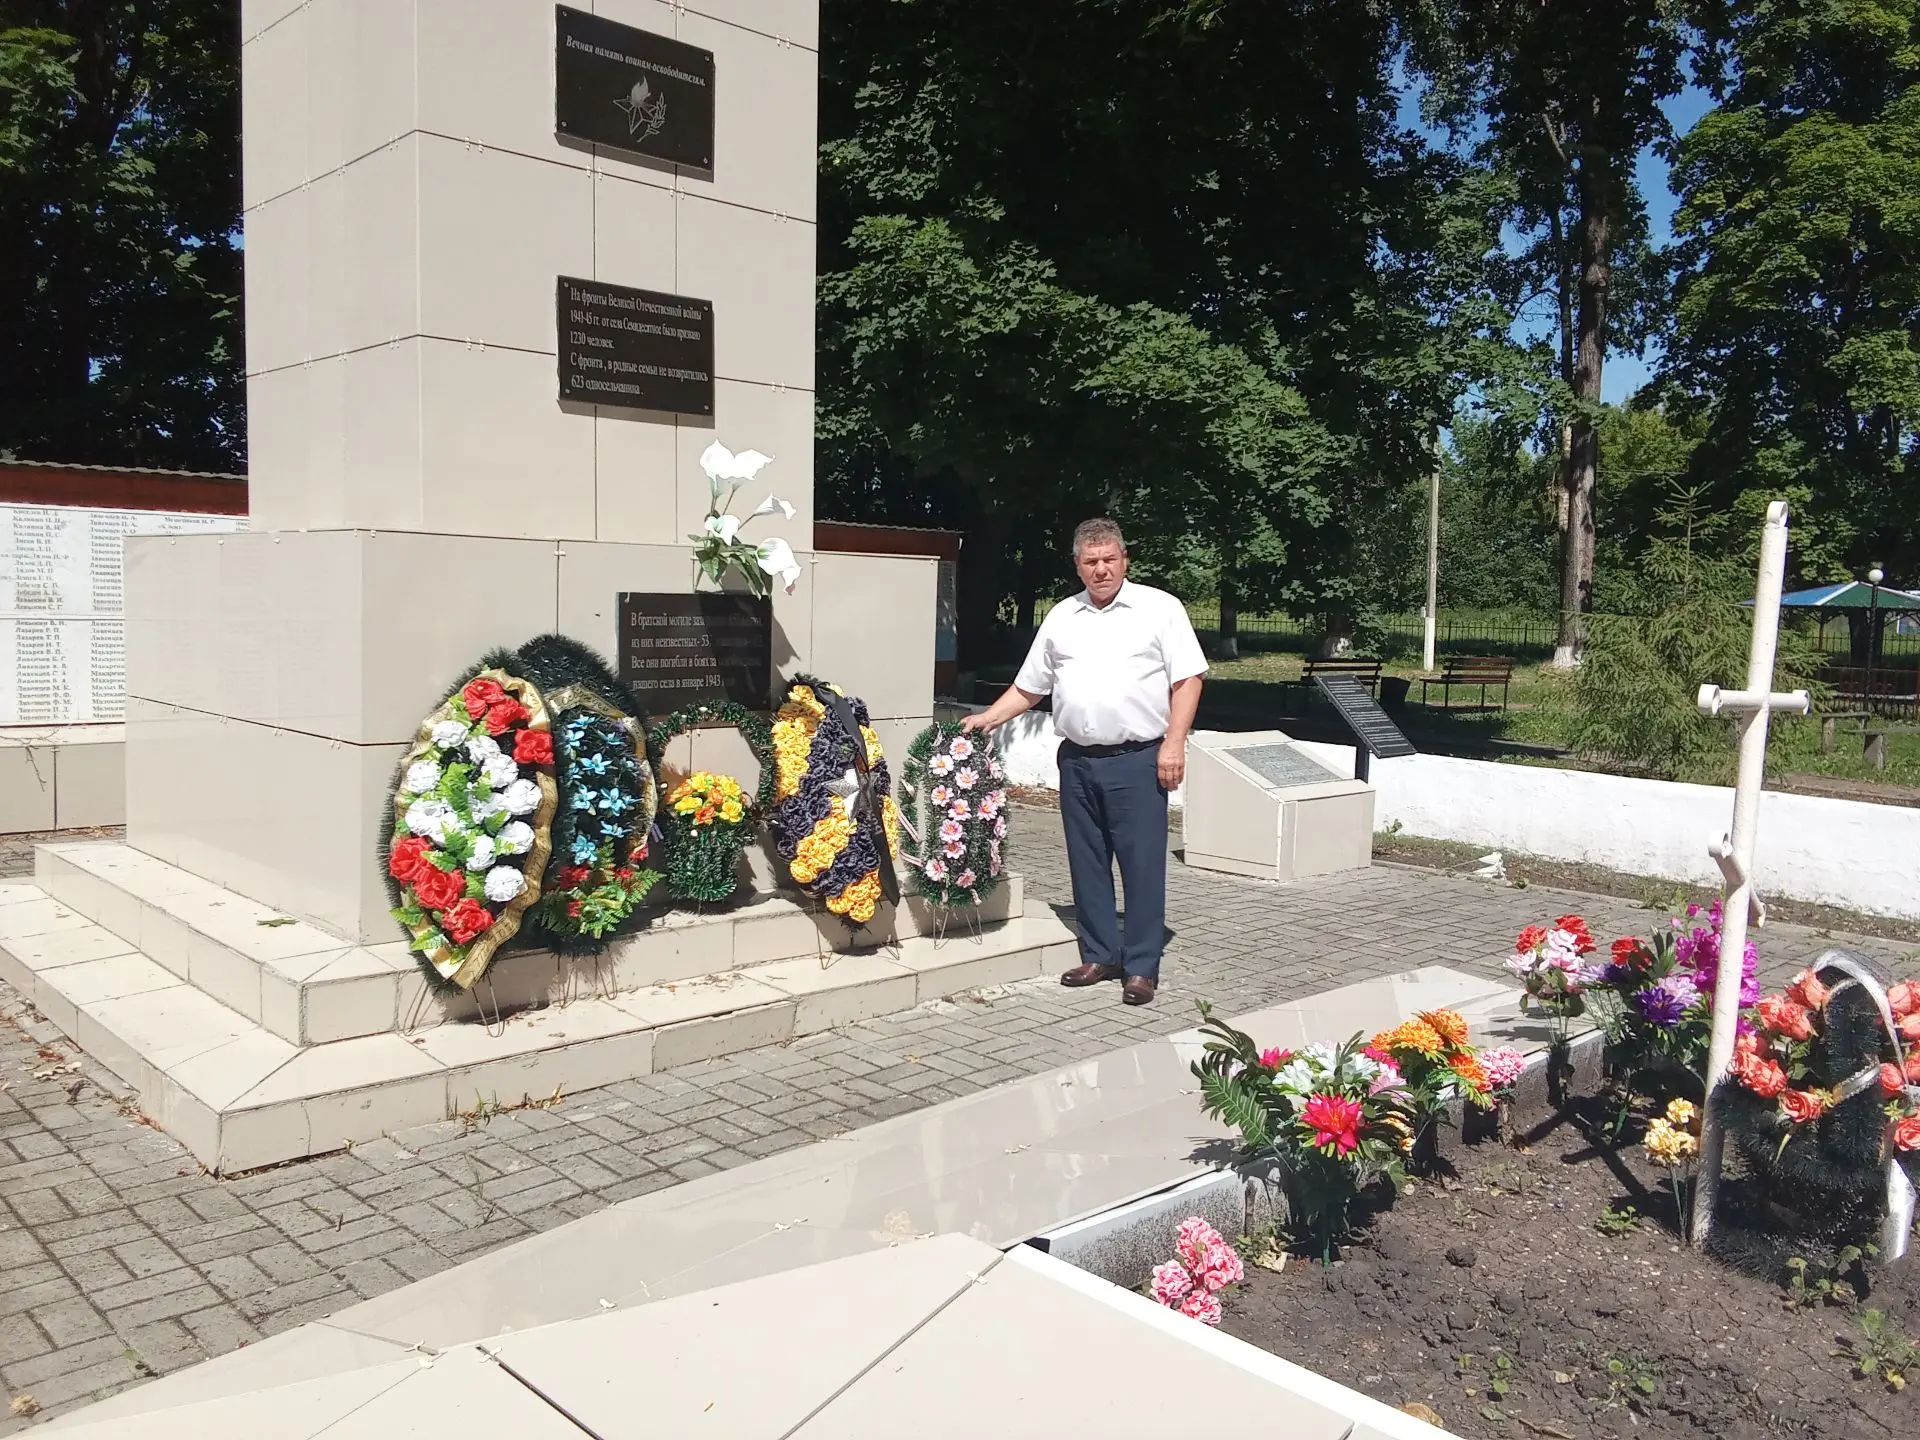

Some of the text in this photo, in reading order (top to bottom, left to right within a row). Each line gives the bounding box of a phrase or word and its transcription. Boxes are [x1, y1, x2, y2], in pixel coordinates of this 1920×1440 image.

[566, 35, 594, 54] Вечная
[595, 46, 624, 62] память
[571, 288, 701, 320] На фронты Великой Отечественной войны
[571, 310, 592, 325] 1941-45
[602, 316, 608, 326] от
[610, 318, 623, 329] села
[662, 322, 676, 336] было
[677, 328, 700, 341] призвано
[570, 332, 615, 349] 1230 человек.
[571, 353, 577, 365] С
[608, 360, 612, 368] в
[614, 359, 637, 373] родные
[638, 363, 657, 374] семьи
[659, 366, 666, 376] не
[668, 368, 708, 382] возвратились
[571, 375, 584, 388] 623
[631, 612, 637, 626] В
[638, 612, 667, 629] братской
[632, 637, 639, 648] из
[641, 637, 654, 647] них
[632, 656, 644, 668] Все
[646, 658, 659, 668] они
[661, 655, 687, 668] погибли
[689, 659, 693, 667] в
[710, 658, 717, 666] за
[633, 679, 658, 690] нашего
[659, 679, 675, 688] села
[676, 680, 680, 688] в
[681, 678, 704, 690] январе
[706, 675, 720, 687] 1943
